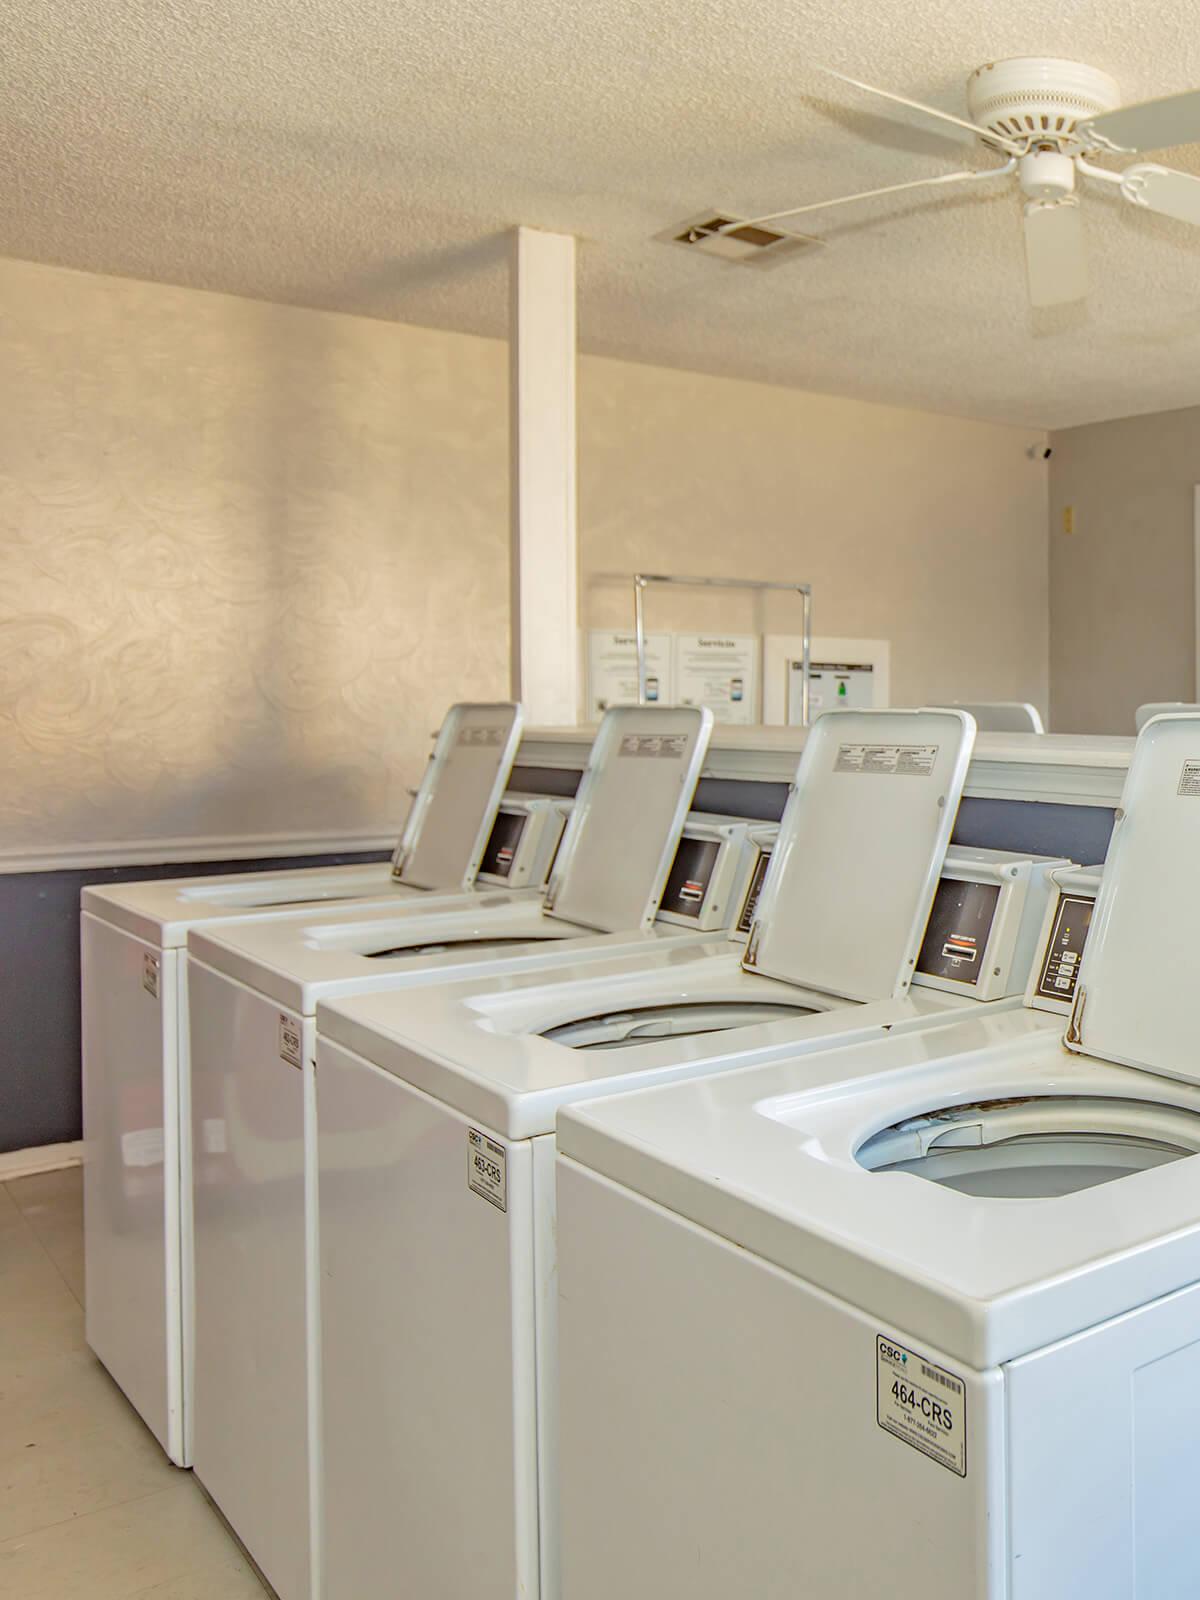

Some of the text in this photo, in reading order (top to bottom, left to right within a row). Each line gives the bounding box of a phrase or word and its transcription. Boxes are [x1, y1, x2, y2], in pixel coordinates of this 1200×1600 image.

[473, 1155, 502, 1183] 463-CRS
[879, 1342, 901, 1362] CSC
[891, 1381, 953, 1430] 464-CRS
